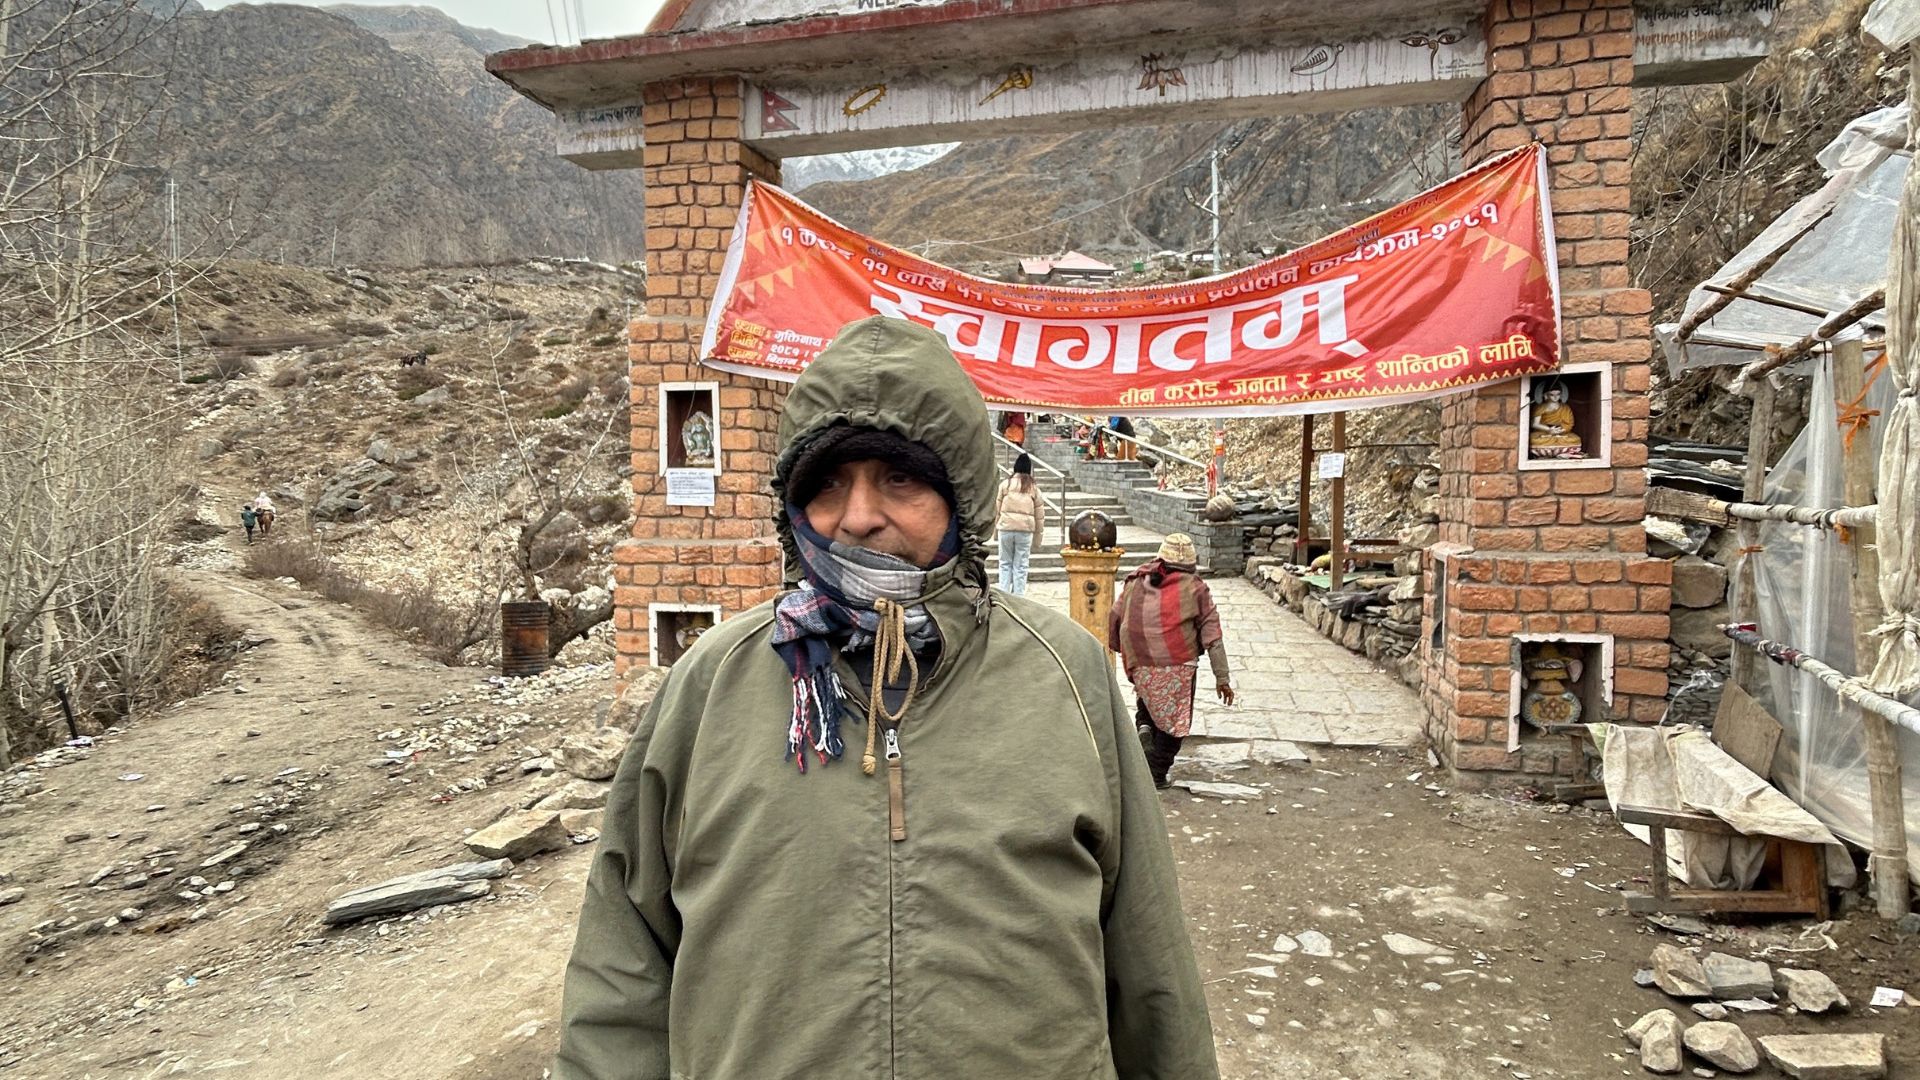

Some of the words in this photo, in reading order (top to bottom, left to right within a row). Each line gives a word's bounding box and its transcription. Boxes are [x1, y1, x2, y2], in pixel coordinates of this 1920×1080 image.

[781, 226, 794, 246] १
[861, 257, 889, 276] ११
[897, 269, 948, 292] लाख
[871, 275, 1369, 374] स्वागतम्
[1119, 387, 1158, 406] तीन
[1164, 378, 1221, 400] करोड
[1229, 374, 1288, 396] जनता
[1296, 372, 1312, 389] र
[1320, 365, 1367, 383] राष्ट्र
[1375, 346, 1470, 379] शान्तिको
[1479, 334, 1535, 364] लागि
